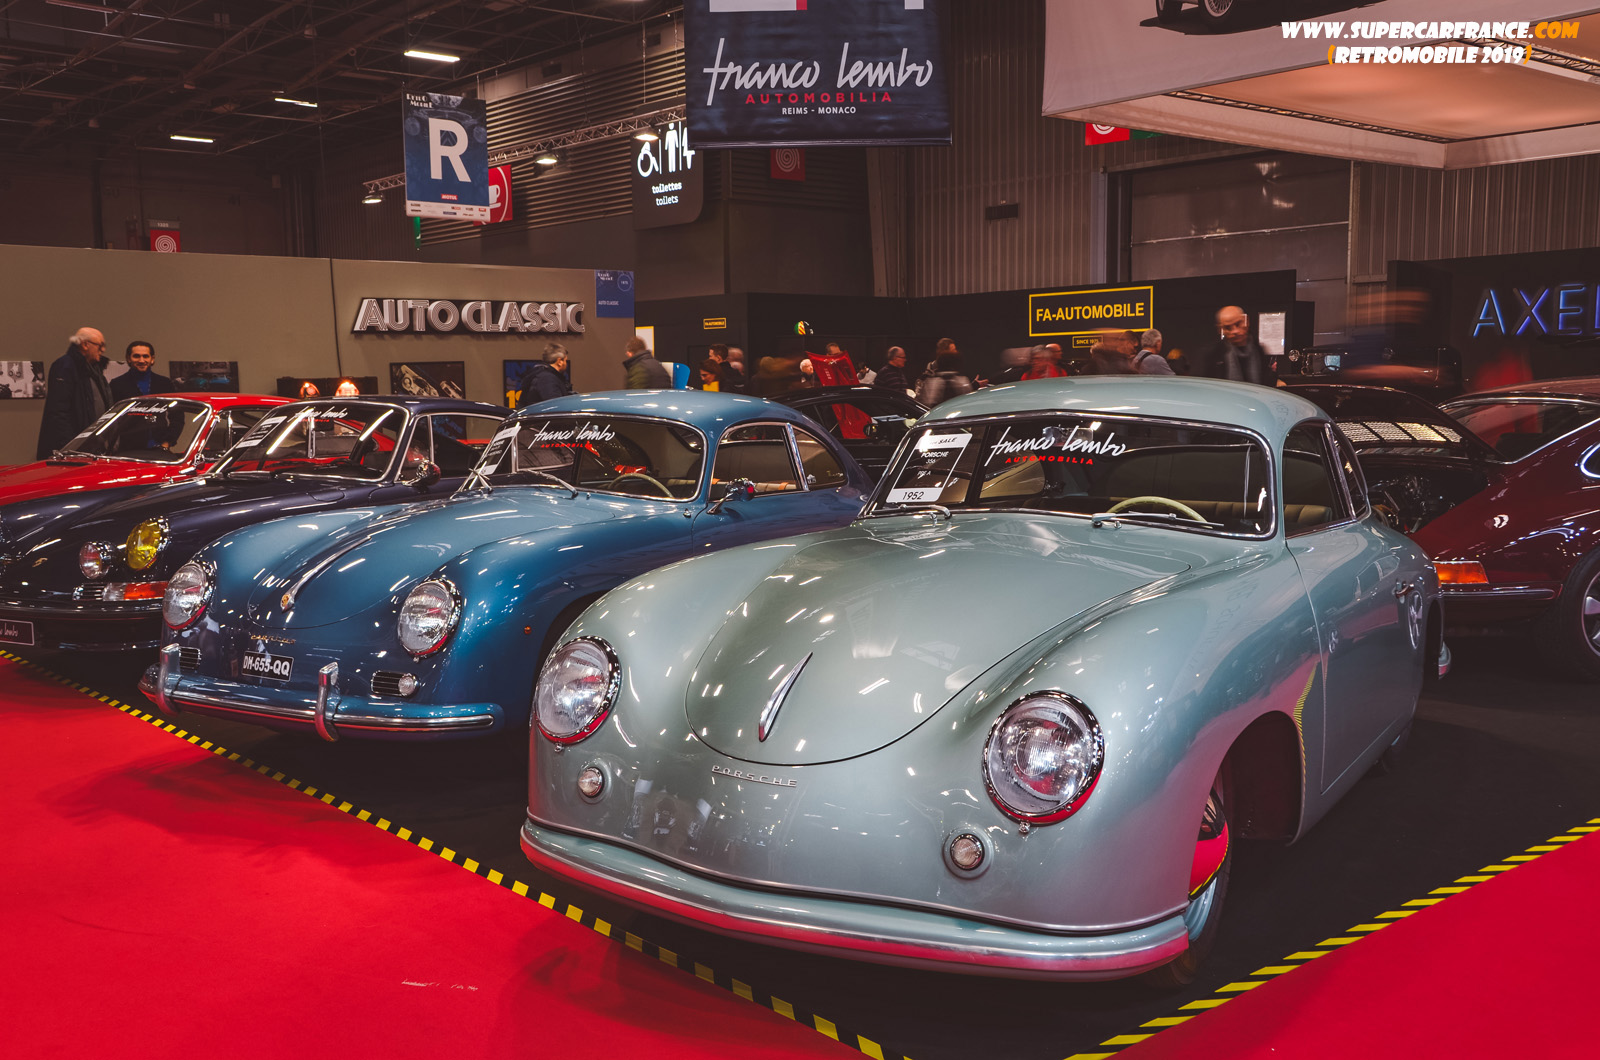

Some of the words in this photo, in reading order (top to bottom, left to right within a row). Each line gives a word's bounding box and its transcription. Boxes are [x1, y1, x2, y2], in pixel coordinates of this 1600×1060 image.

[836, 42, 933, 89] lembo
[745, 92, 892, 104] AUTOMOBILIA
[818, 106, 857, 114] MONACO
[428, 117, 472, 183] R
[651, 182, 682, 194] toilettes
[656, 195, 679, 206] toilets
[353, 298, 459, 333] AUTO
[461, 300, 586, 333] CLASSIC
[1036, 302, 1145, 322] FA-AUTOMOBILE
[576, 420, 616, 441] lembo
[938, 437, 957, 445] SALE
[1061, 425, 1126, 456] lembo
[1005, 455, 1094, 465] AUTOMOBILIA
[903, 491, 924, 500] 1952
[711, 764, 798, 788] PORSCHE
